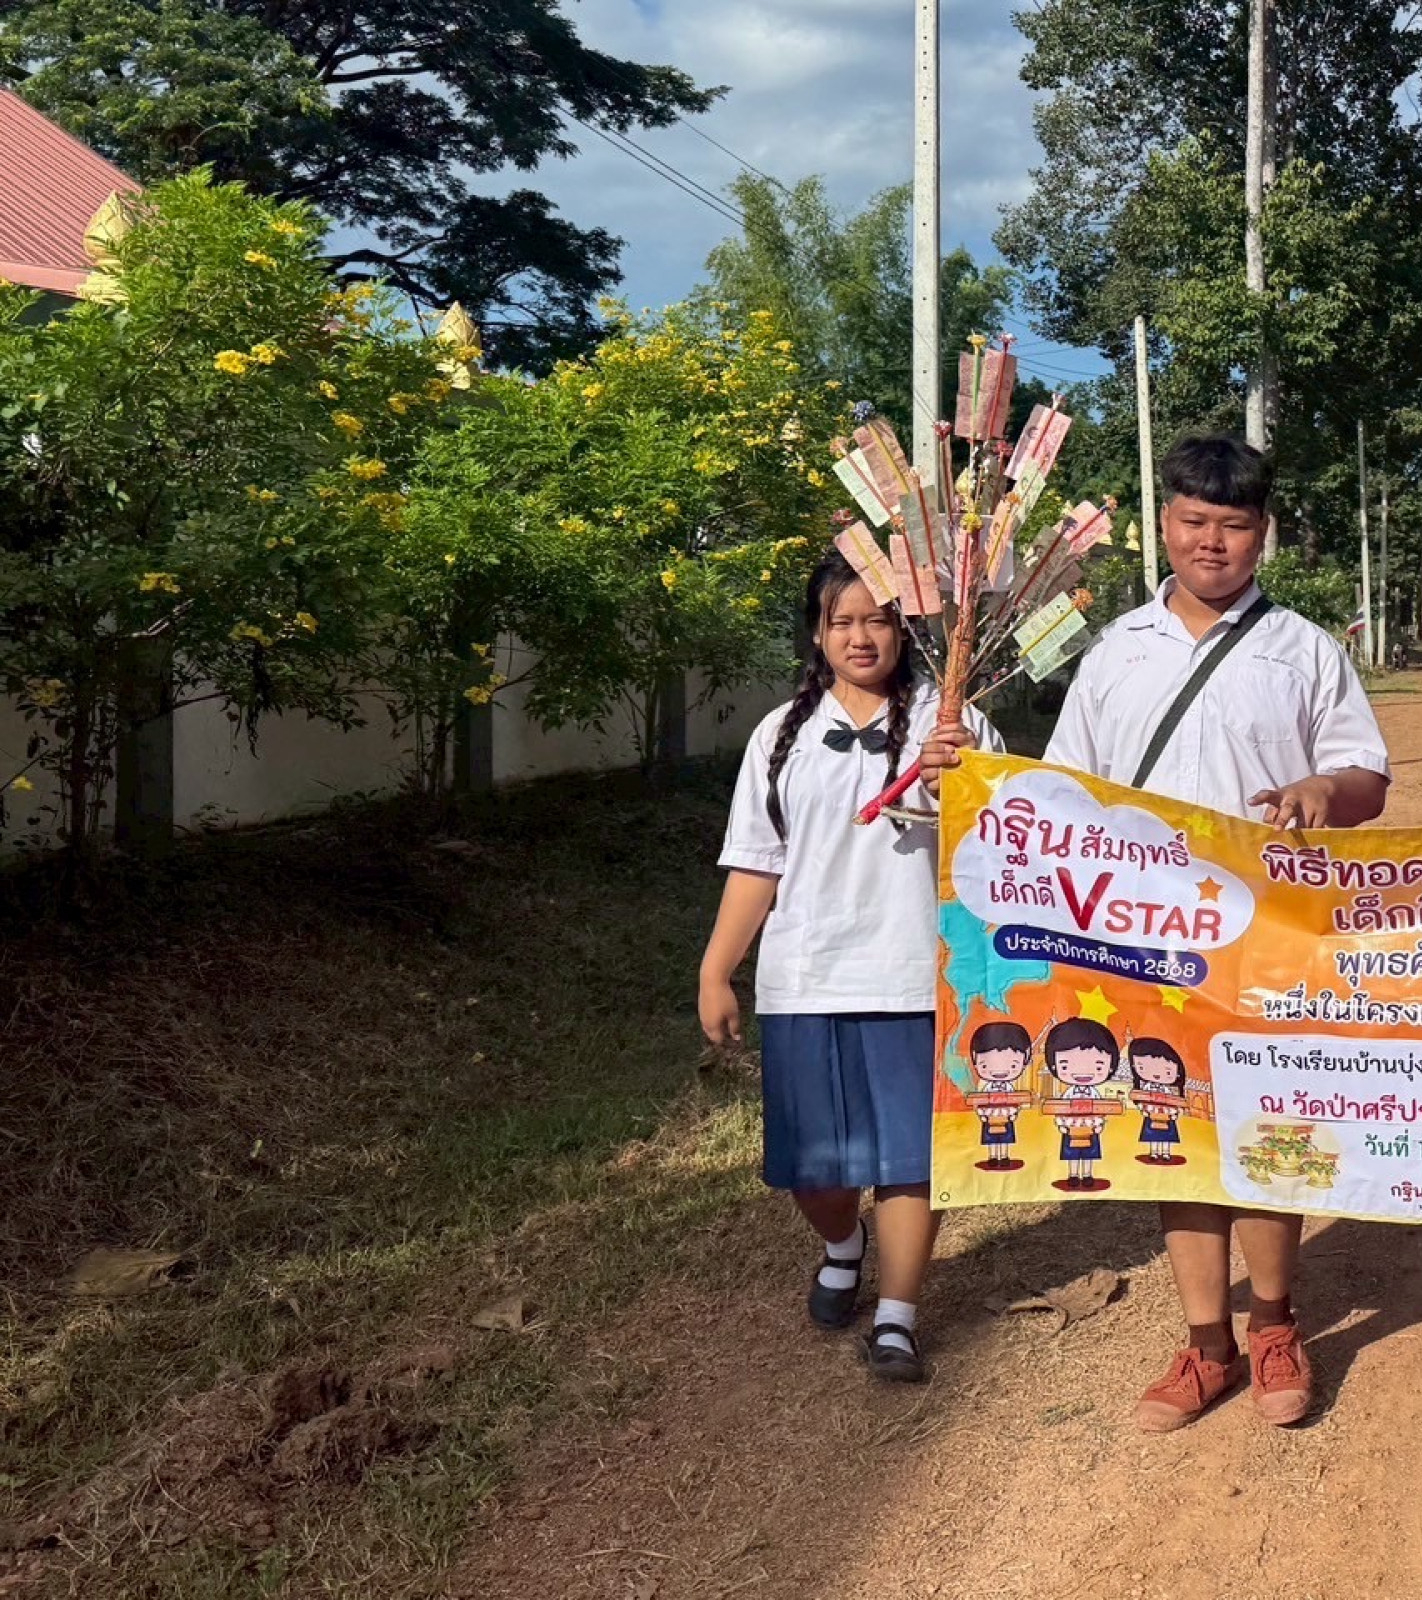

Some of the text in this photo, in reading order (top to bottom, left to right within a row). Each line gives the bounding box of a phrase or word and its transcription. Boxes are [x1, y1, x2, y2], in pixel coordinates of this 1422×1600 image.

[978, 797, 1191, 871] กฐิน สัมฤทธิ์
[989, 869, 1057, 908] เด็กดี
[1004, 932, 1196, 979] ประจำปีการศึกษา 2568
[1222, 1042, 1261, 1066] โดย
[1259, 1094, 1285, 1113] ณ
[1364, 1129, 1410, 1158] วันที่
